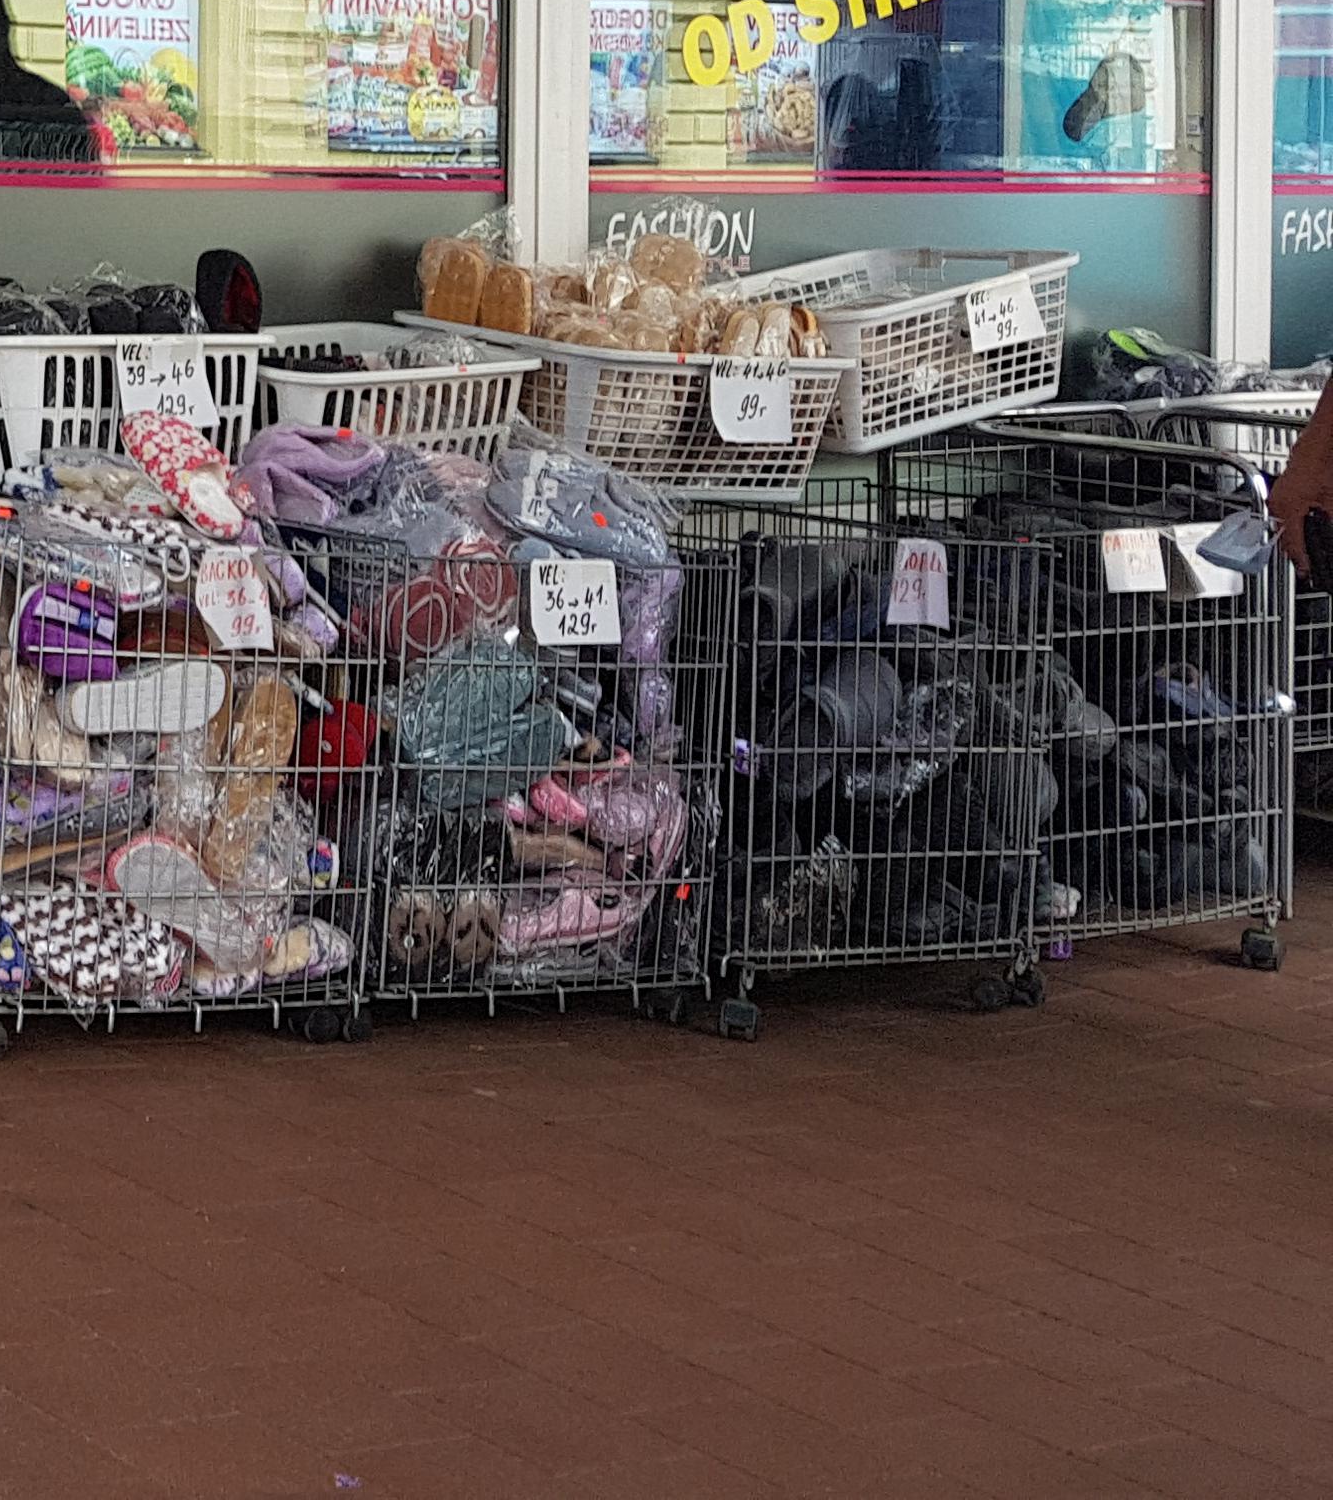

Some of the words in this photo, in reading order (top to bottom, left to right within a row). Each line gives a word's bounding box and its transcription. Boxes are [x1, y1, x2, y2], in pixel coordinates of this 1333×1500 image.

[126, 364, 146, 386] 39
[171, 358, 195, 386] 46
[545, 587, 565, 612] 36
